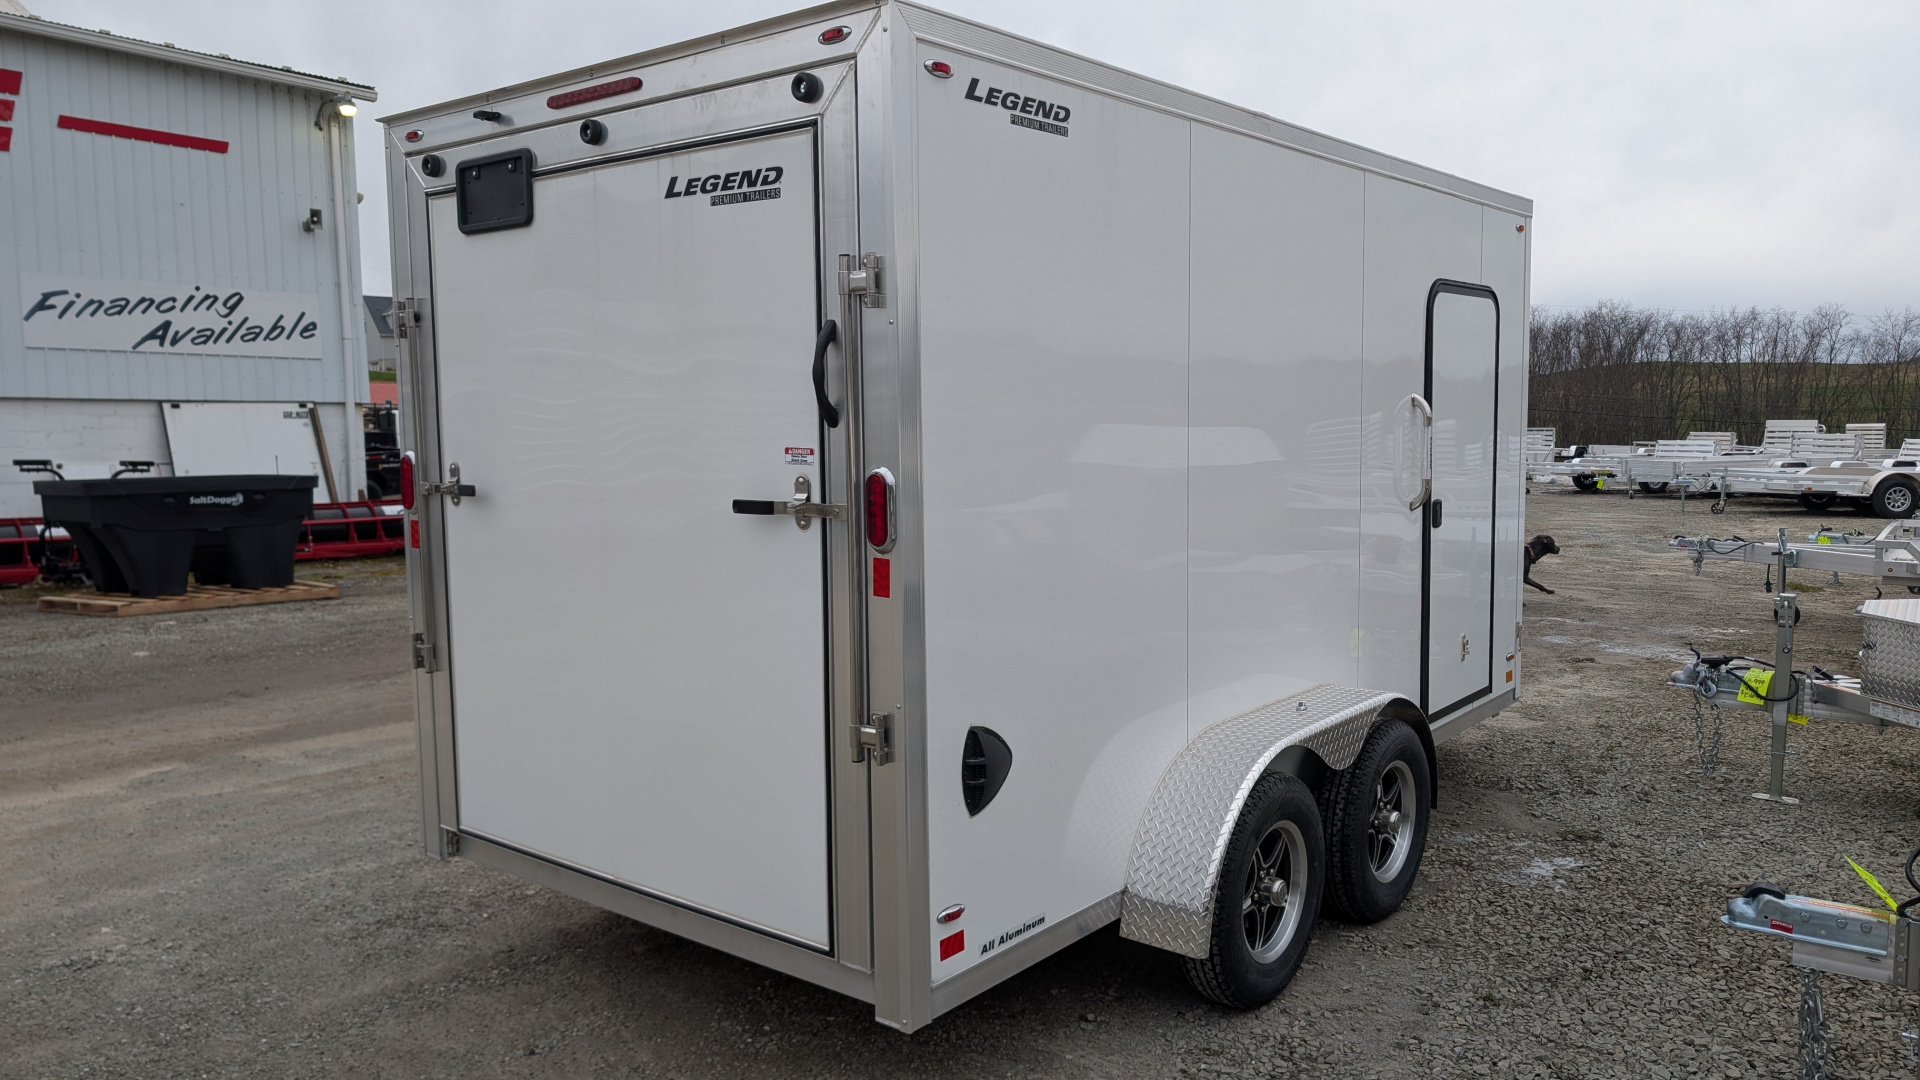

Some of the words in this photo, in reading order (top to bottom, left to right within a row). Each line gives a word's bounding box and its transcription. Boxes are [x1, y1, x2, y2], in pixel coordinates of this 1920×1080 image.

[965, 77, 1071, 123] LEGEND
[1010, 114, 1040, 131] PREMIUM
[1041, 121, 1069, 137] TRAILERS
[664, 166, 784, 199] LEGEND
[710, 191, 744, 206] PREMIUM
[745, 188, 781, 202] TRAILERS
[23, 286, 245, 321] Financing
[132, 311, 318, 350] Available
[981, 939, 995, 955] All
[998, 916, 1045, 946] Aluminum
